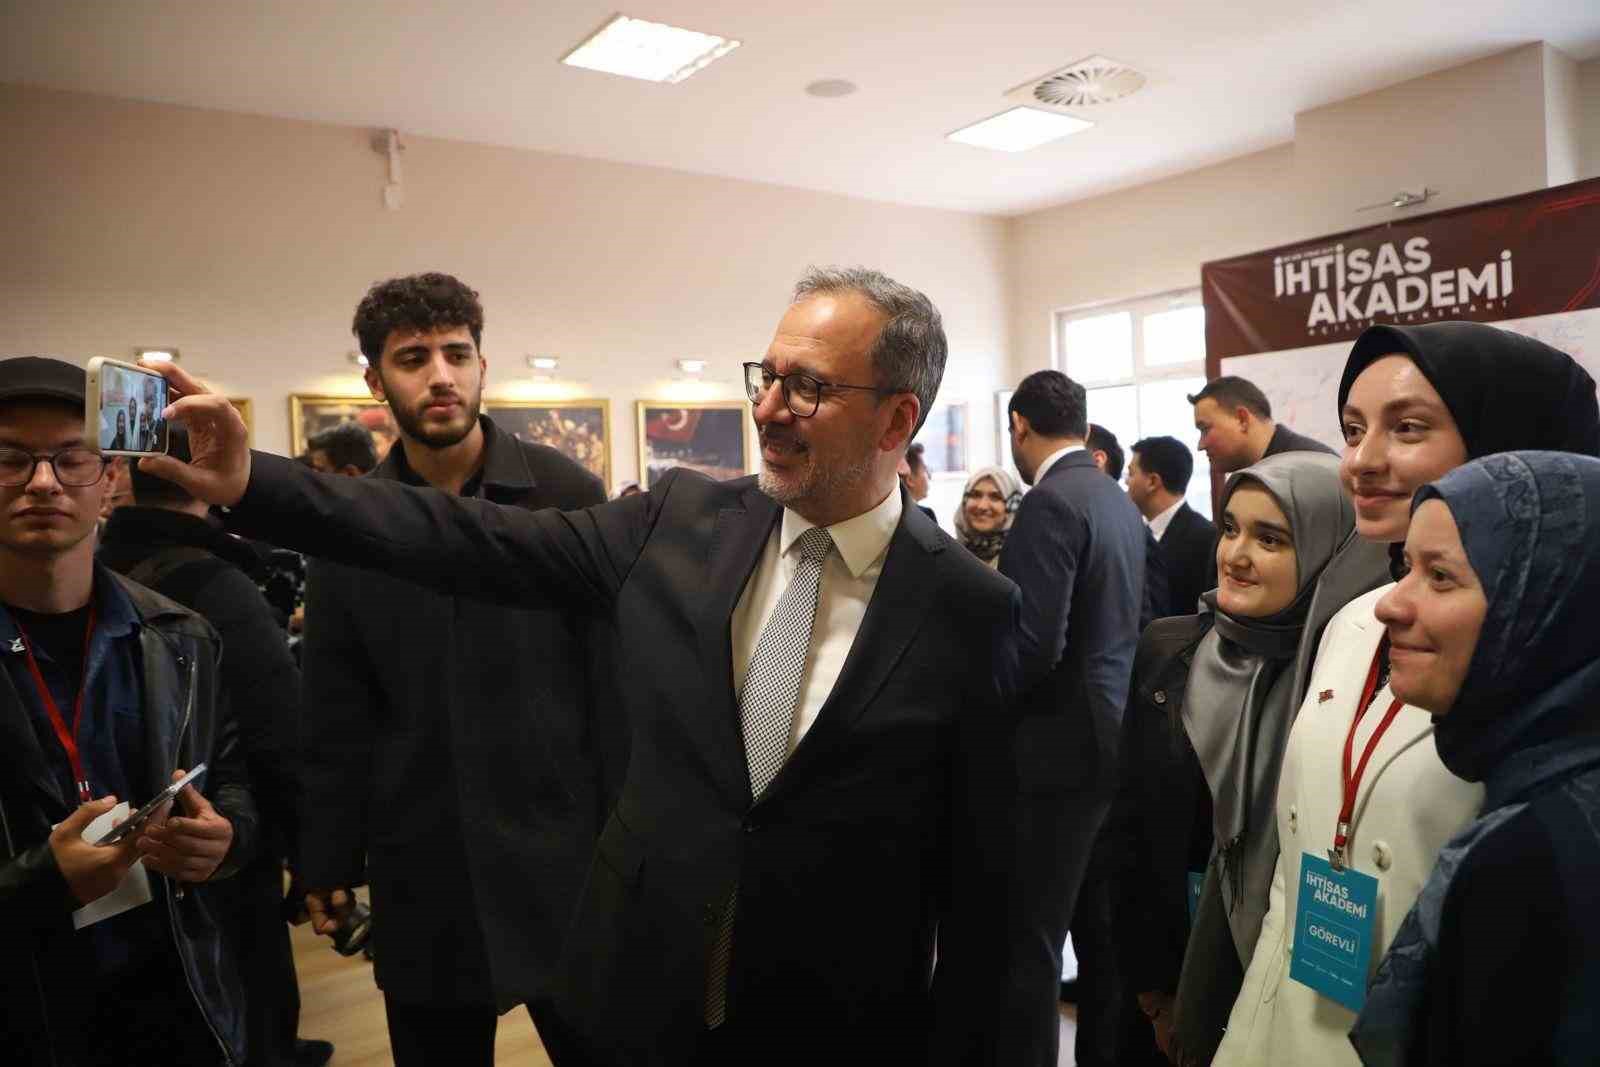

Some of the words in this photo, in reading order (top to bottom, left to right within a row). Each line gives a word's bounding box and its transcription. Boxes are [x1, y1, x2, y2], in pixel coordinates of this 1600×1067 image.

[1274, 237, 1431, 297] İHTİSAS
[1307, 249, 1513, 327] AKADEMİ
[1306, 870, 1349, 899] İHTİSAS
[1314, 889, 1367, 918] AKADEMİ
[1309, 925, 1355, 953] GÖREVLİ
